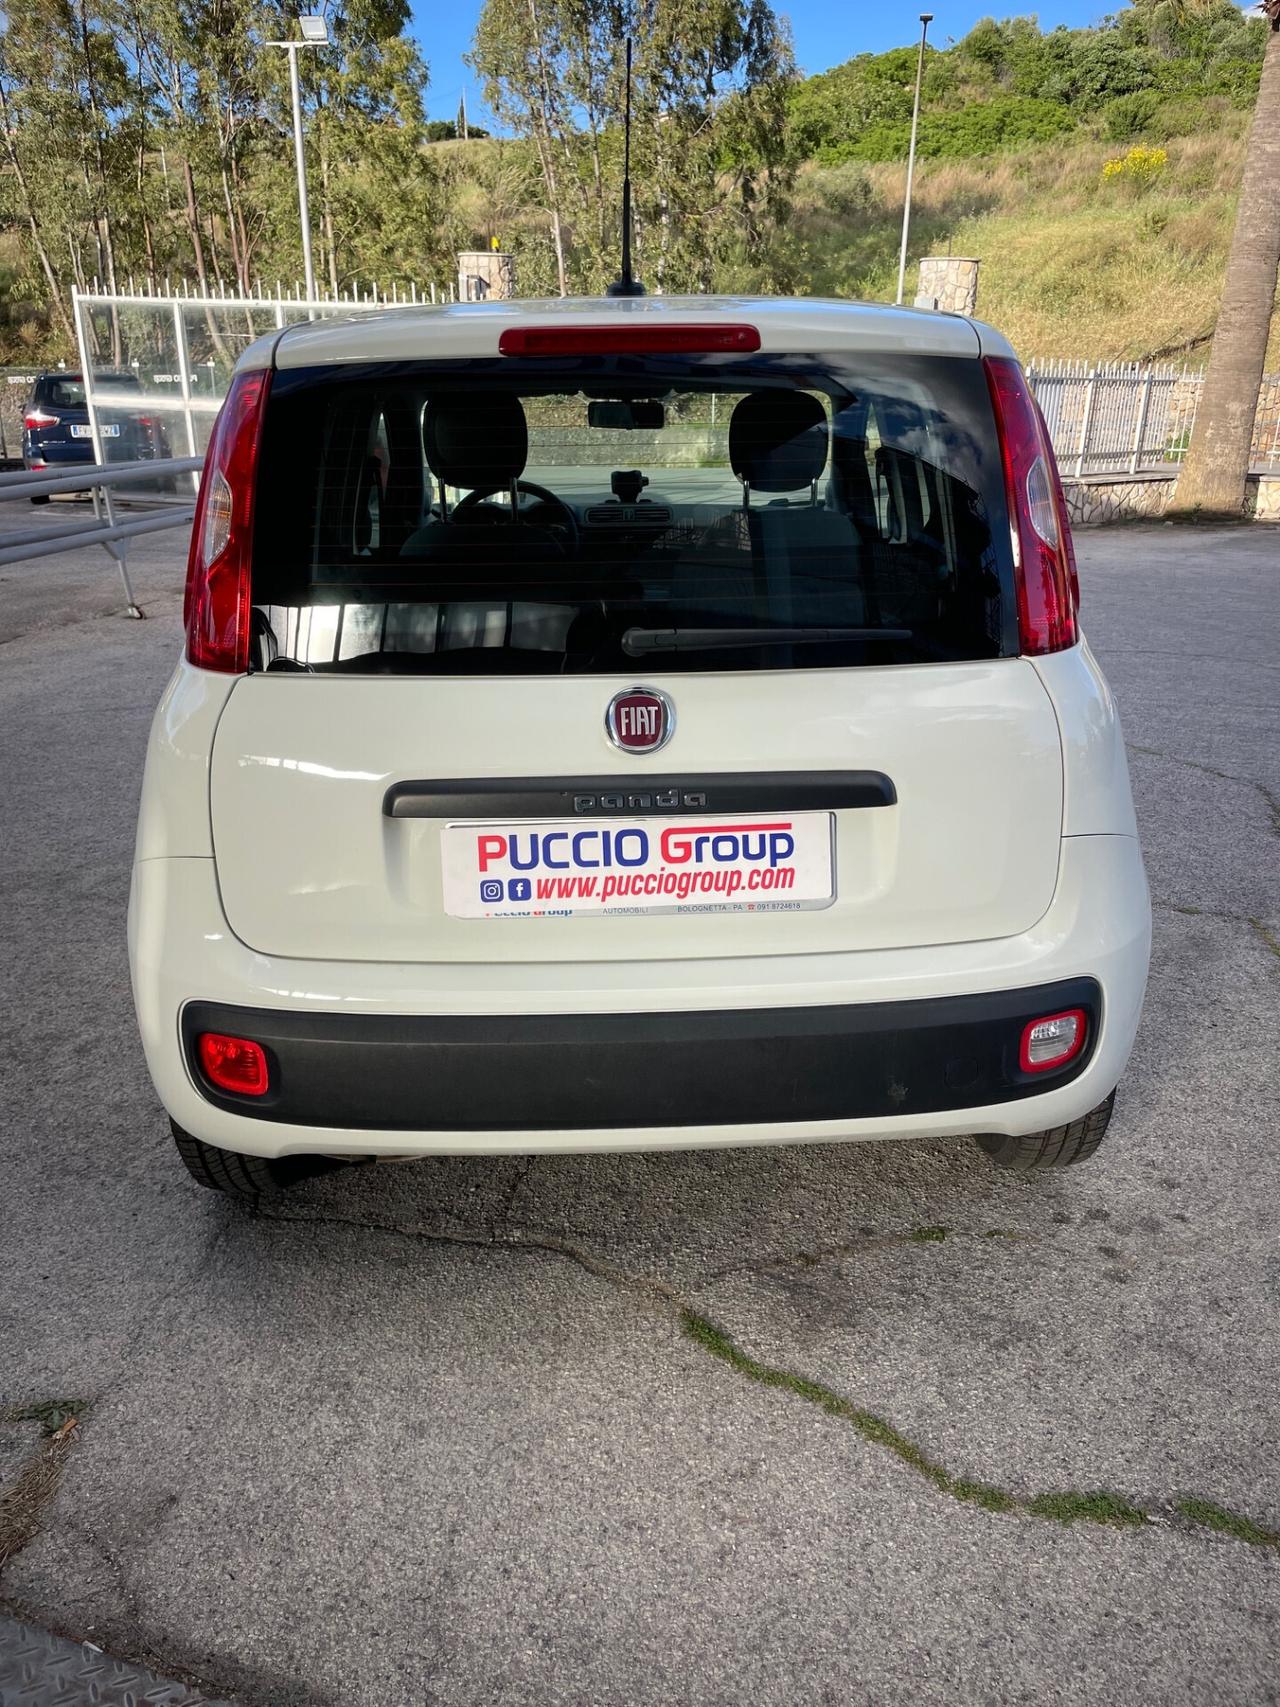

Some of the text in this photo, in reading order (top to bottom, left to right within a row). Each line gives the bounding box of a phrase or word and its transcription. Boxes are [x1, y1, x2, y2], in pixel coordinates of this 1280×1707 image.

[620, 706, 659, 736] FIAT
[573, 788, 707, 813] panda
[477, 822, 795, 872] PUCCIO Group
[536, 866, 796, 902] www.pucciogroup.com
[602, 906, 649, 915] AUTOMOBILI
[677, 904, 728, 913] BOLOGNETTA
[757, 903, 771, 911] 091
